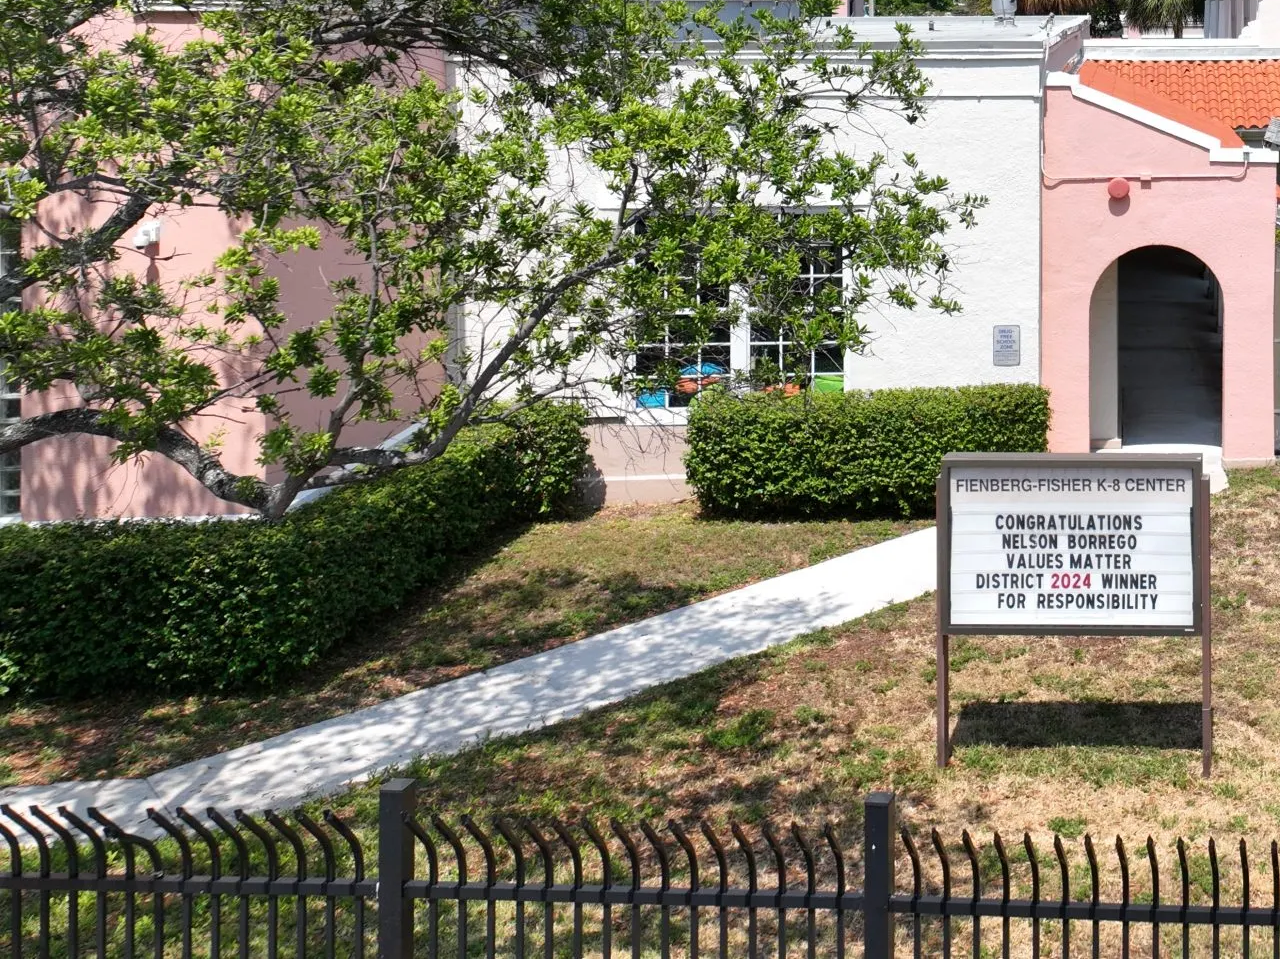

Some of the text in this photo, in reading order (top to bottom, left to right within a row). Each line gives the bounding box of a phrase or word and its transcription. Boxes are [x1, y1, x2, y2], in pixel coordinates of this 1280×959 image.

[956, 478, 1185, 493] FIENBERG-FISHER K-8 CENTER
[995, 514, 1142, 530] CONGRATULATIONS
[1002, 534, 1137, 550] NELSON BORREGO
[1006, 553, 1132, 569] VALUES MATTER
[976, 573, 1157, 589] DISTRICT 2024 WINNER
[998, 593, 1158, 610] FOR RESPONSIBILITY
